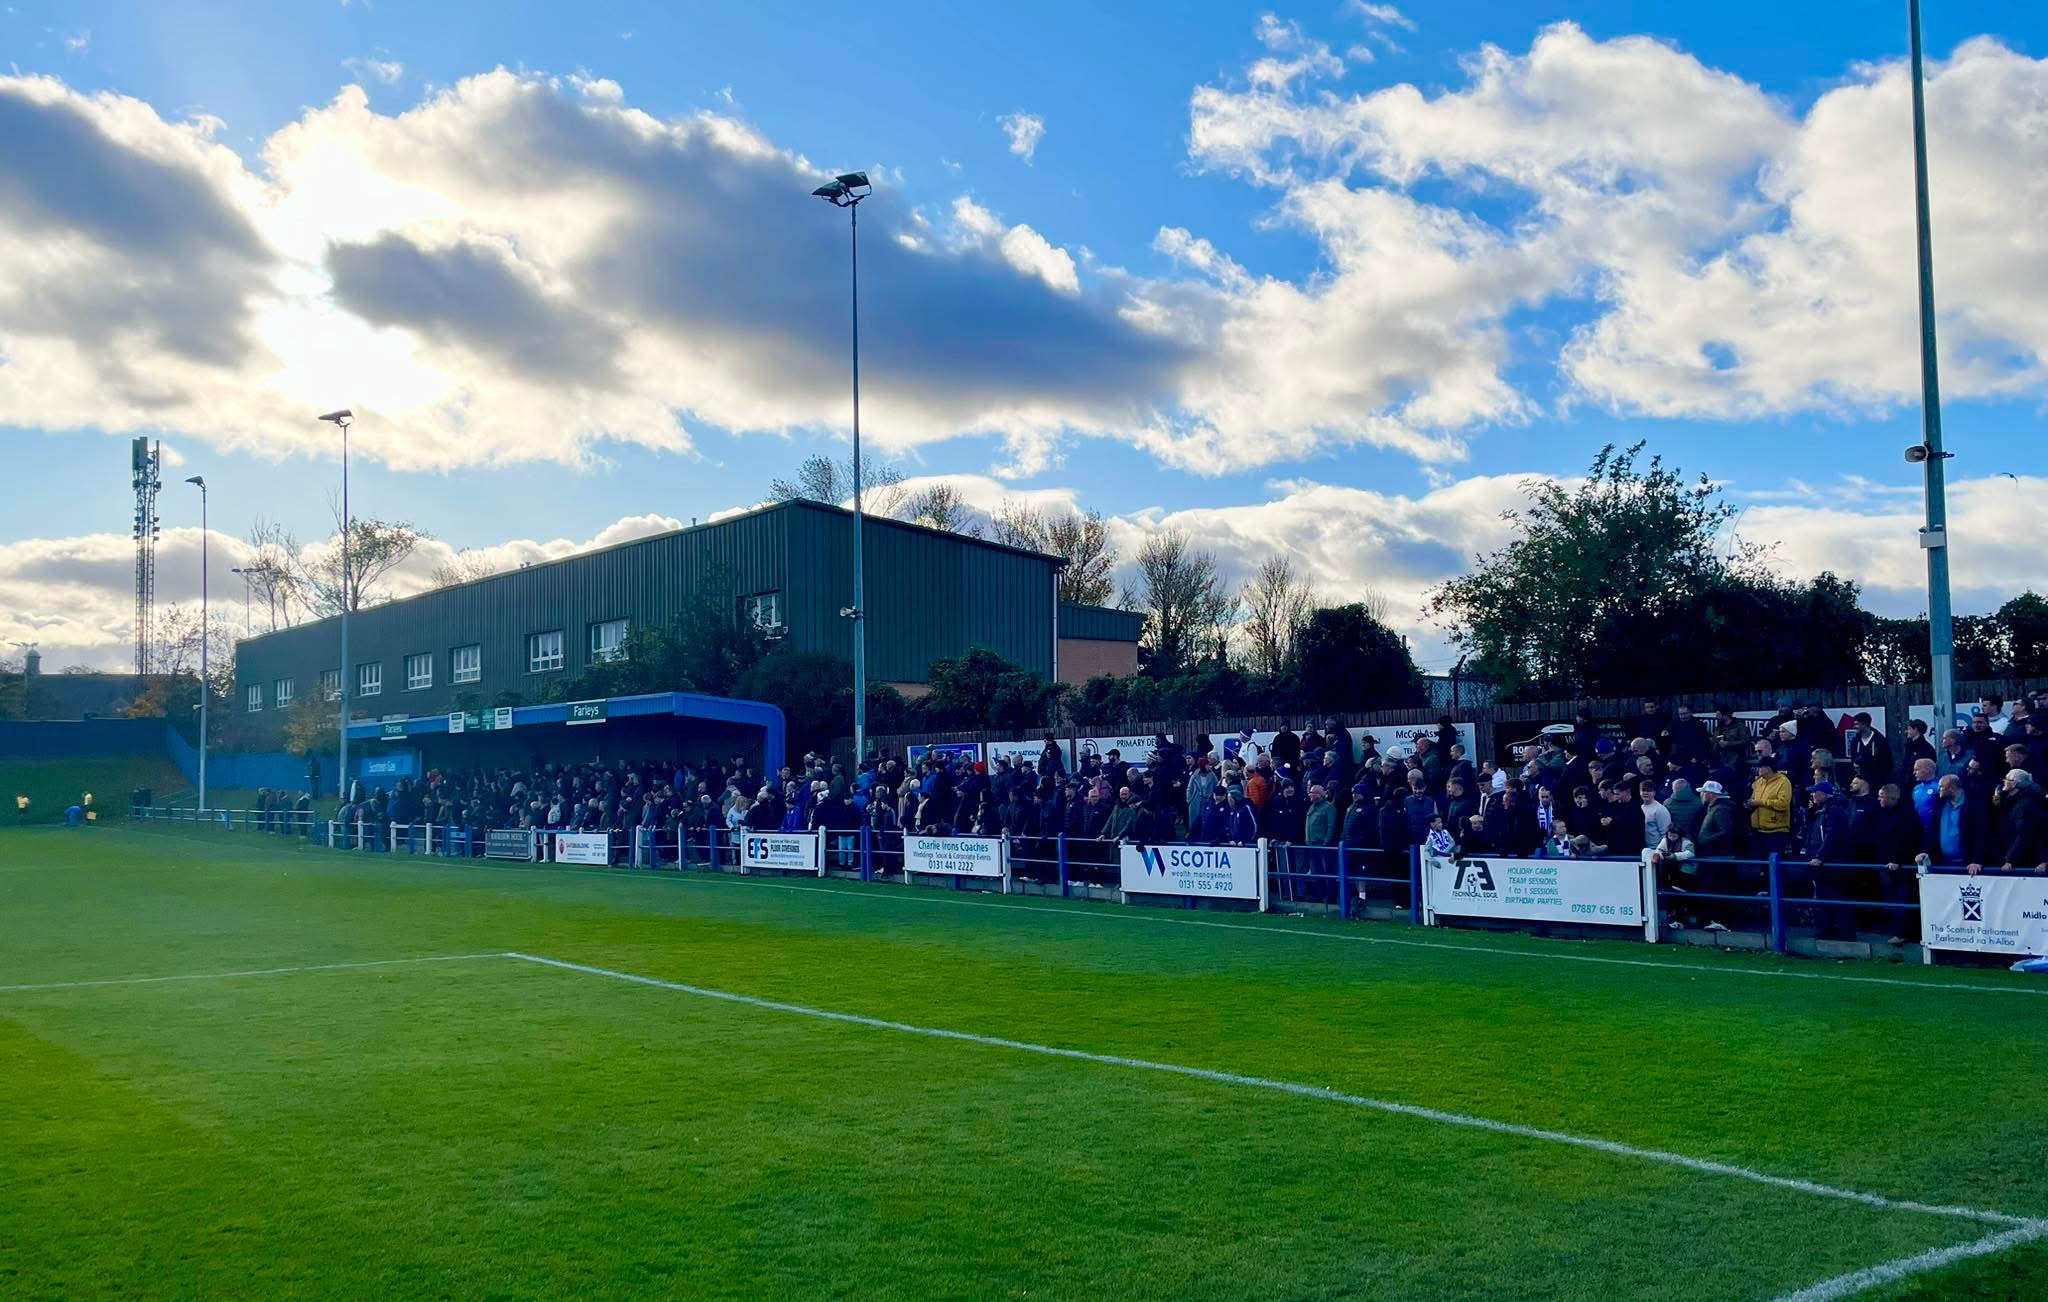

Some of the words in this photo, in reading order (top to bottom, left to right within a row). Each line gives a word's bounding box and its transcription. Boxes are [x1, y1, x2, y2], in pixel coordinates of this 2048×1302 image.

[572, 704, 600, 718] Farleys
[1116, 738, 1145, 748] PRIMARY
[747, 837, 769, 860] EFS
[918, 840, 940, 851] Charlie
[942, 841, 959, 852] Irons
[960, 841, 989, 853] Coaches
[928, 859, 943, 870] 0131
[944, 860, 956, 870] 441
[957, 861, 974, 871] 2222
[1171, 850, 1231, 868] SCOTIA
[1171, 870, 1191, 878] wealth
[1193, 871, 1232, 880] management
[1507, 867, 1533, 875] HOLIDAY
[1535, 867, 1558, 876] CAMPS
[1178, 879, 1194, 889] 0131
[1198, 880, 1212, 890] 555
[1214, 881, 1233, 891] 4920
[1509, 876, 1526, 884] TEAM
[1528, 877, 1558, 886] SESSIONS
[1514, 887, 1522, 895] to
[1529, 887, 1559, 896] SESSIONS
[1504, 896, 1535, 904] BIRTHDAY
[1537, 897, 1563, 906] PARTIES
[1571, 904, 1597, 914] 07887
[1619, 906, 1634, 916] 185
[1930, 924, 1944, 932] The
[1946, 925, 1975, 934] Scottish
[1977, 926, 2019, 937] Parliament
[1935, 934, 1974, 944] Parlamaid
